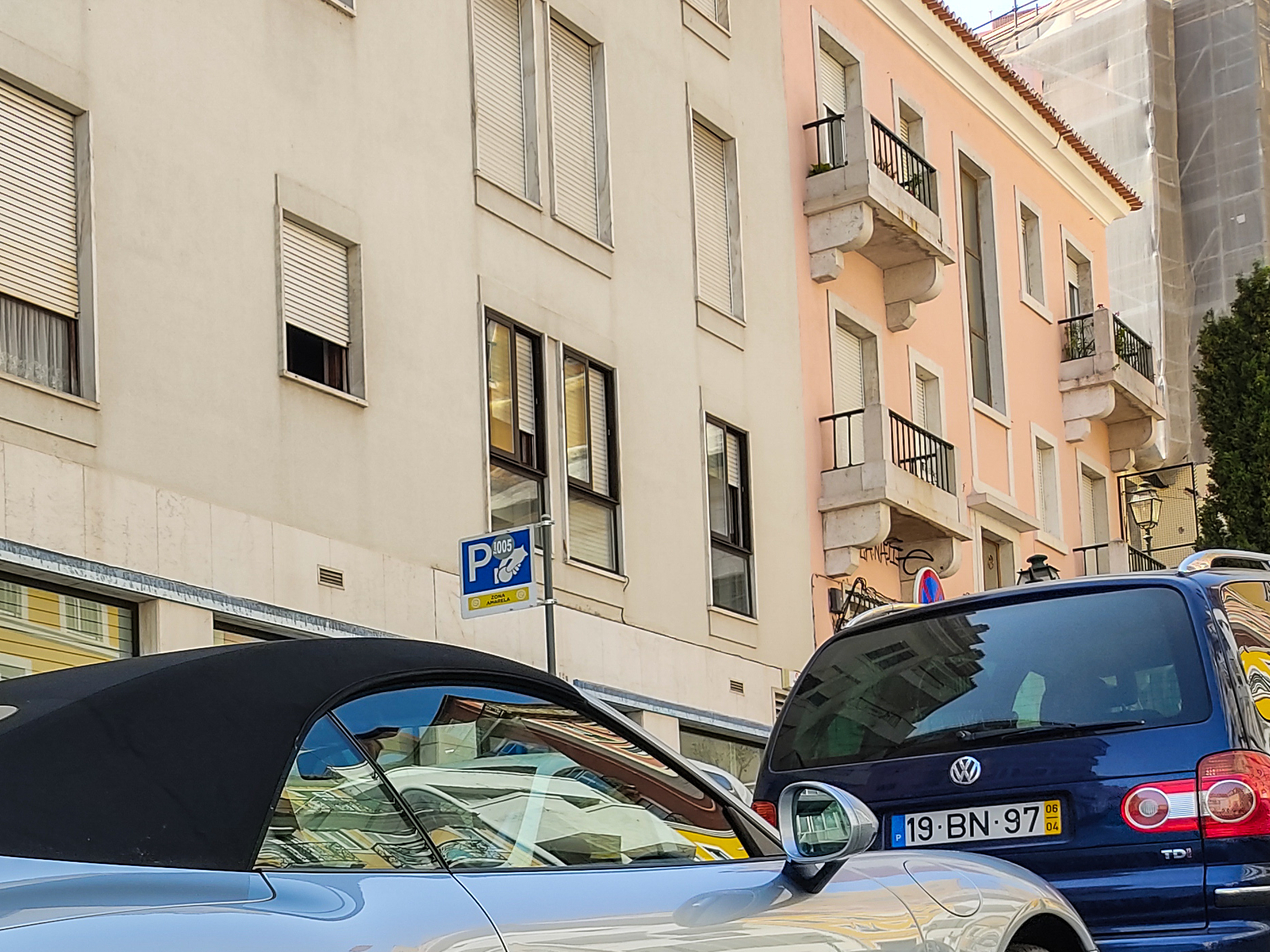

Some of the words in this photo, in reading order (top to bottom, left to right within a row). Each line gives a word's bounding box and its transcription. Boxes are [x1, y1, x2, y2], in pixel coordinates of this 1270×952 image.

[468, 543, 492, 582] P
[1045, 804, 1058, 813] 06
[1046, 822, 1059, 832] 04
[895, 834, 902, 842] P
